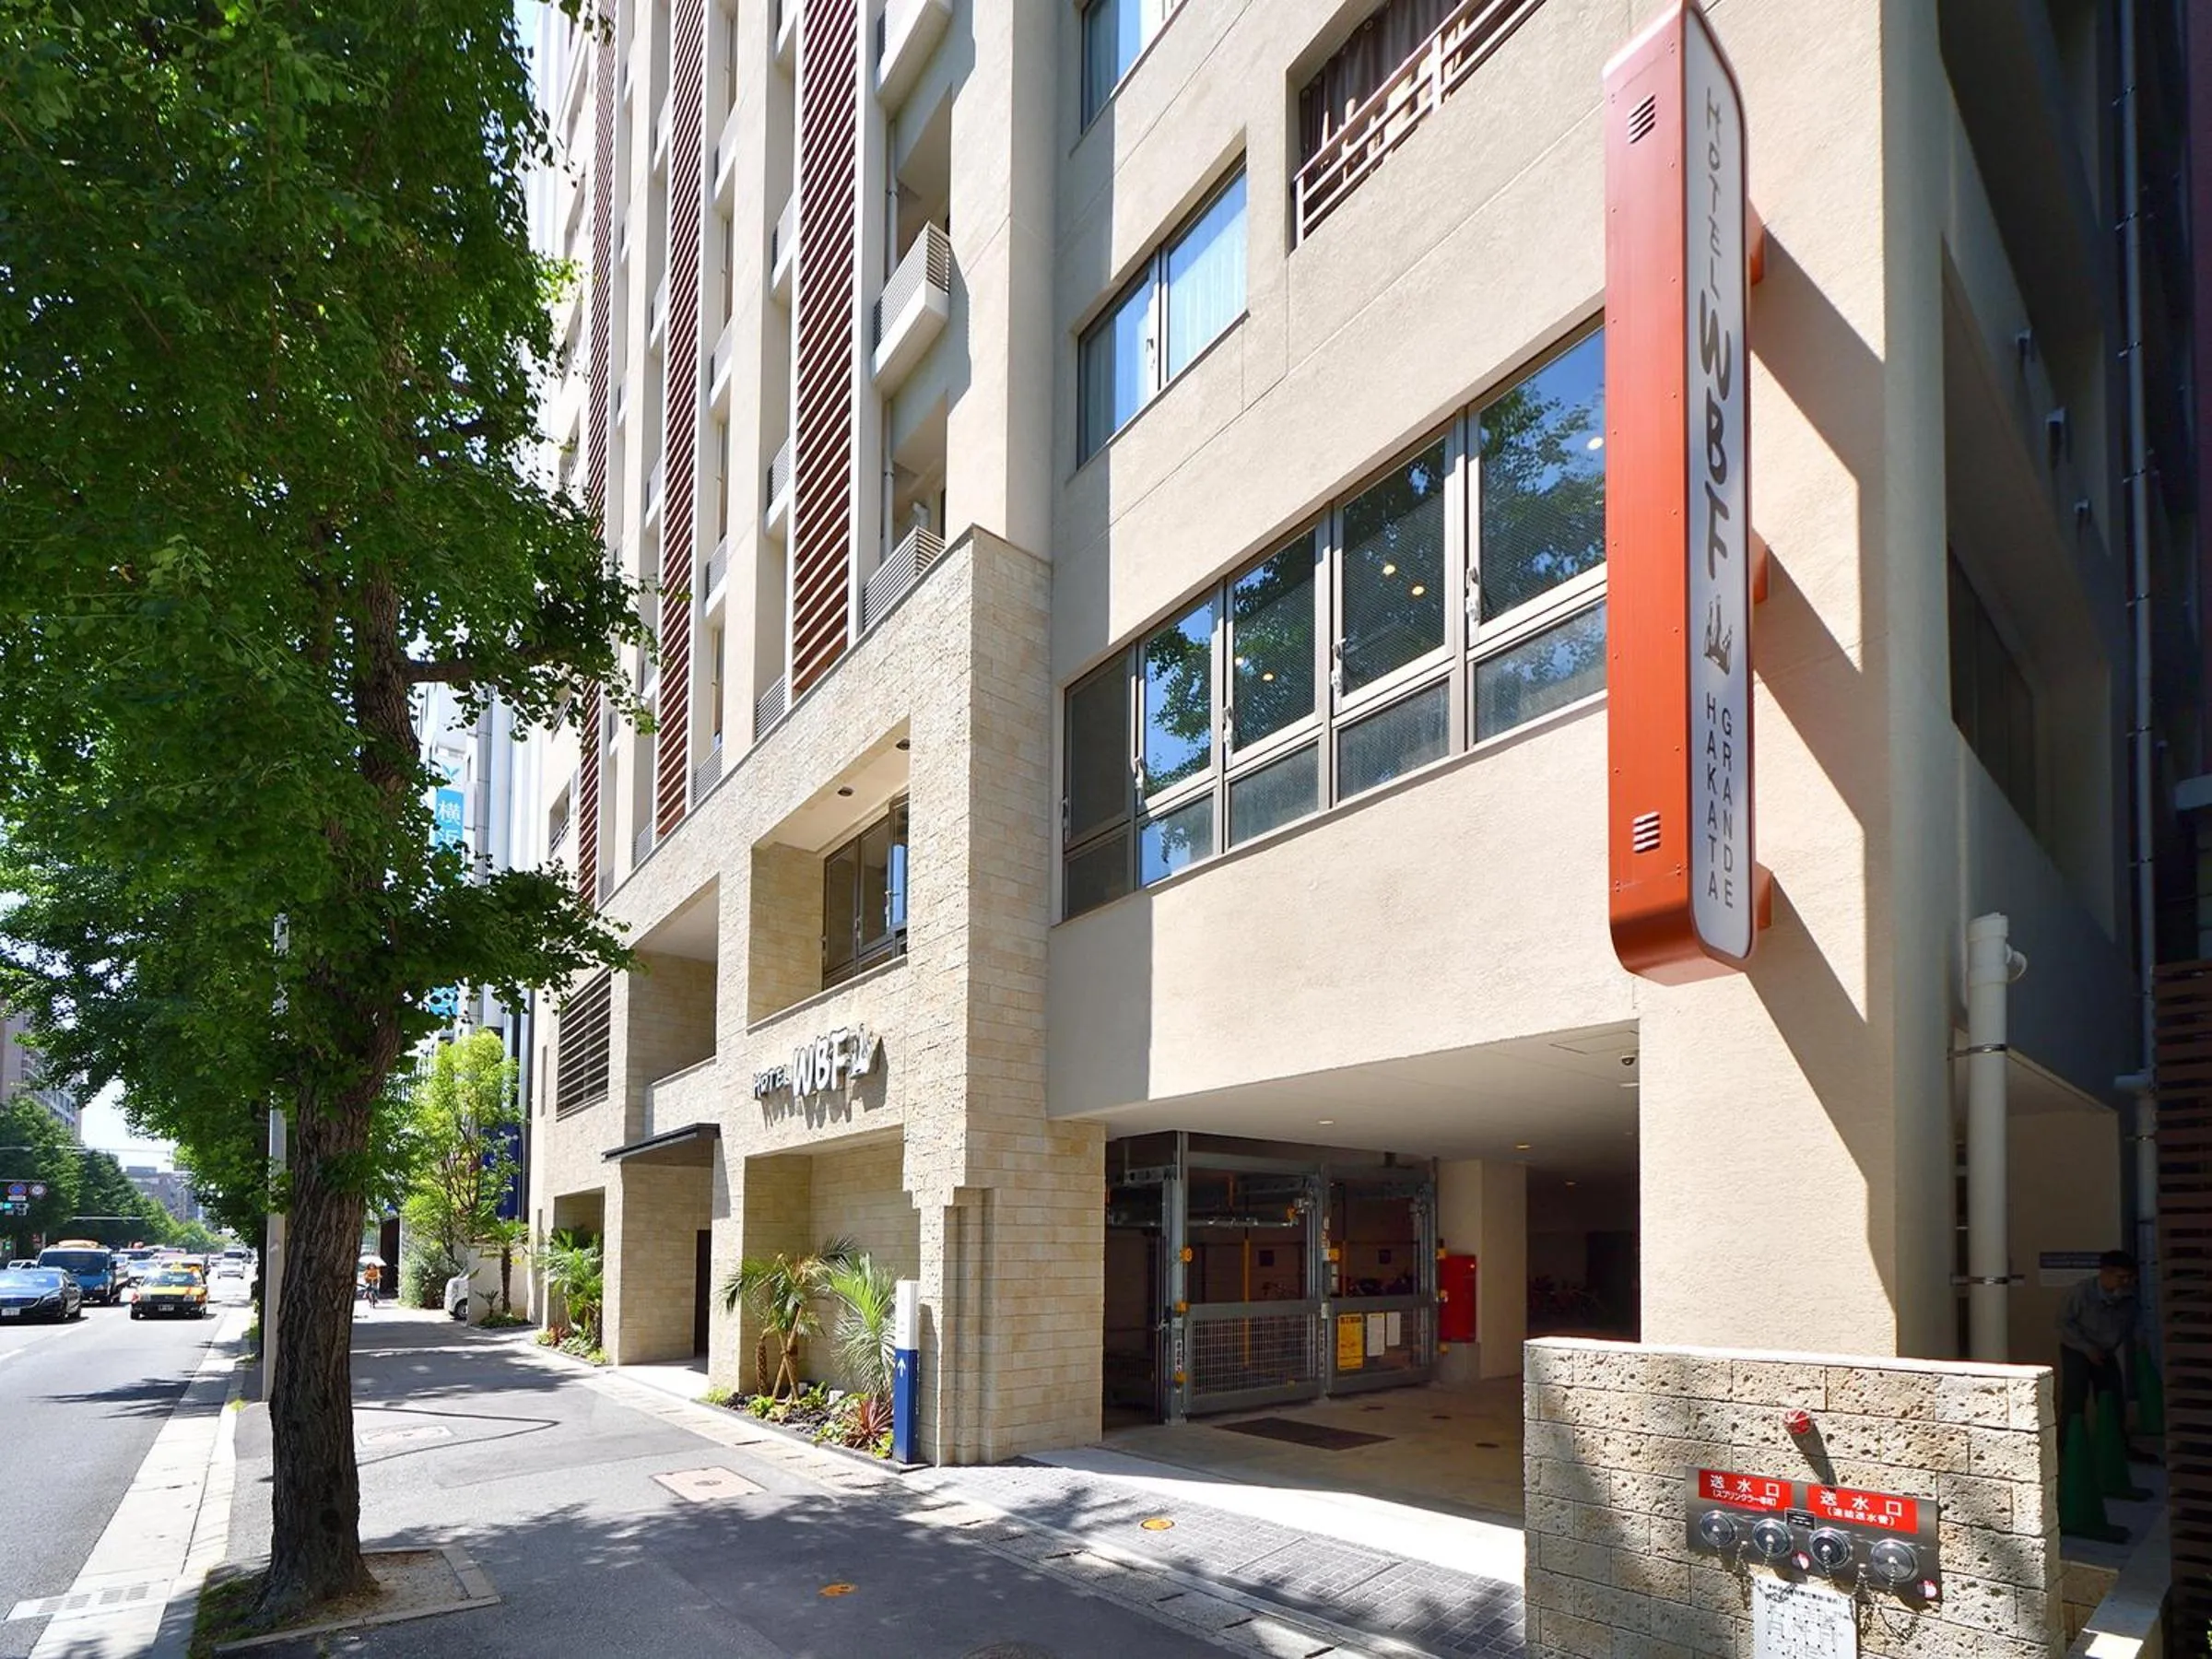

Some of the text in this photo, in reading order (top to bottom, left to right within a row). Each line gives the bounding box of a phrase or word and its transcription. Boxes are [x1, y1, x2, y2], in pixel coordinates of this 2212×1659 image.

[1700, 86, 1732, 581] HOTEL WBF
[1706, 691, 1719, 900] HAKATA
[1721, 707, 1734, 909] GRANDE
[753, 1027, 851, 1099] HOTEL WBF
[1710, 1474, 1781, 1499] 送水口
[1819, 1488, 1902, 1517] 送水口
